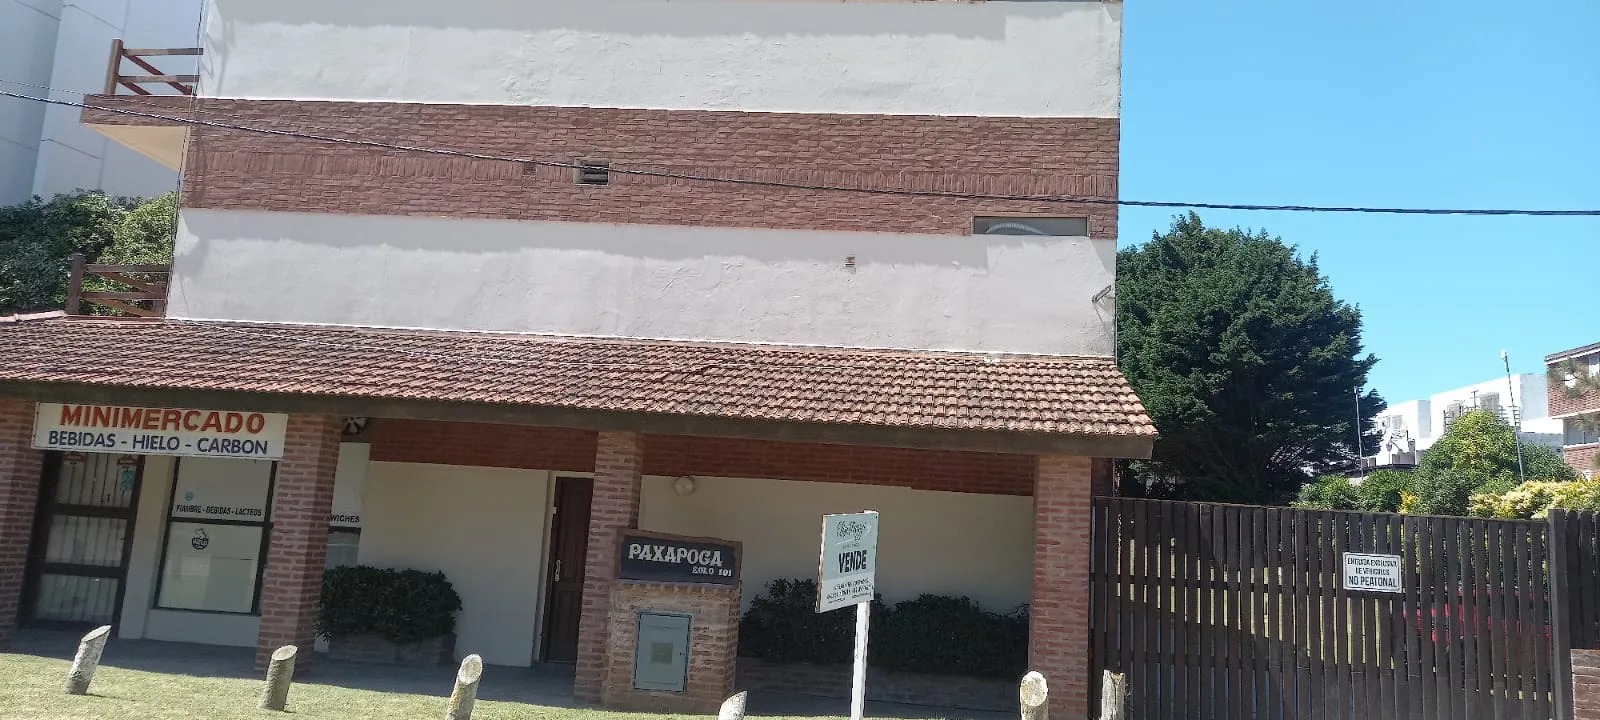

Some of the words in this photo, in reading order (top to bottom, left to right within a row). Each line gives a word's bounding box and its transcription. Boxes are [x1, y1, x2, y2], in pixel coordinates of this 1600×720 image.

[60, 405, 265, 434] MINIMERCADO
[48, 430, 116, 448] BEBIDAS
[132, 434, 180, 451] HIELO
[197, 437, 268, 455] CARBON
[176, 504, 202, 514] FIAMBRE
[206, 506, 231, 515] BEBIDAS
[235, 507, 262, 517] LACTEOS
[628, 543, 723, 567] PAXAPOGA
[838, 549, 868, 574] VENDE
[1347, 558, 1370, 566] ENTRADA
[1348, 576, 1359, 585] NO
[1361, 577, 1397, 587] PEATONAL
